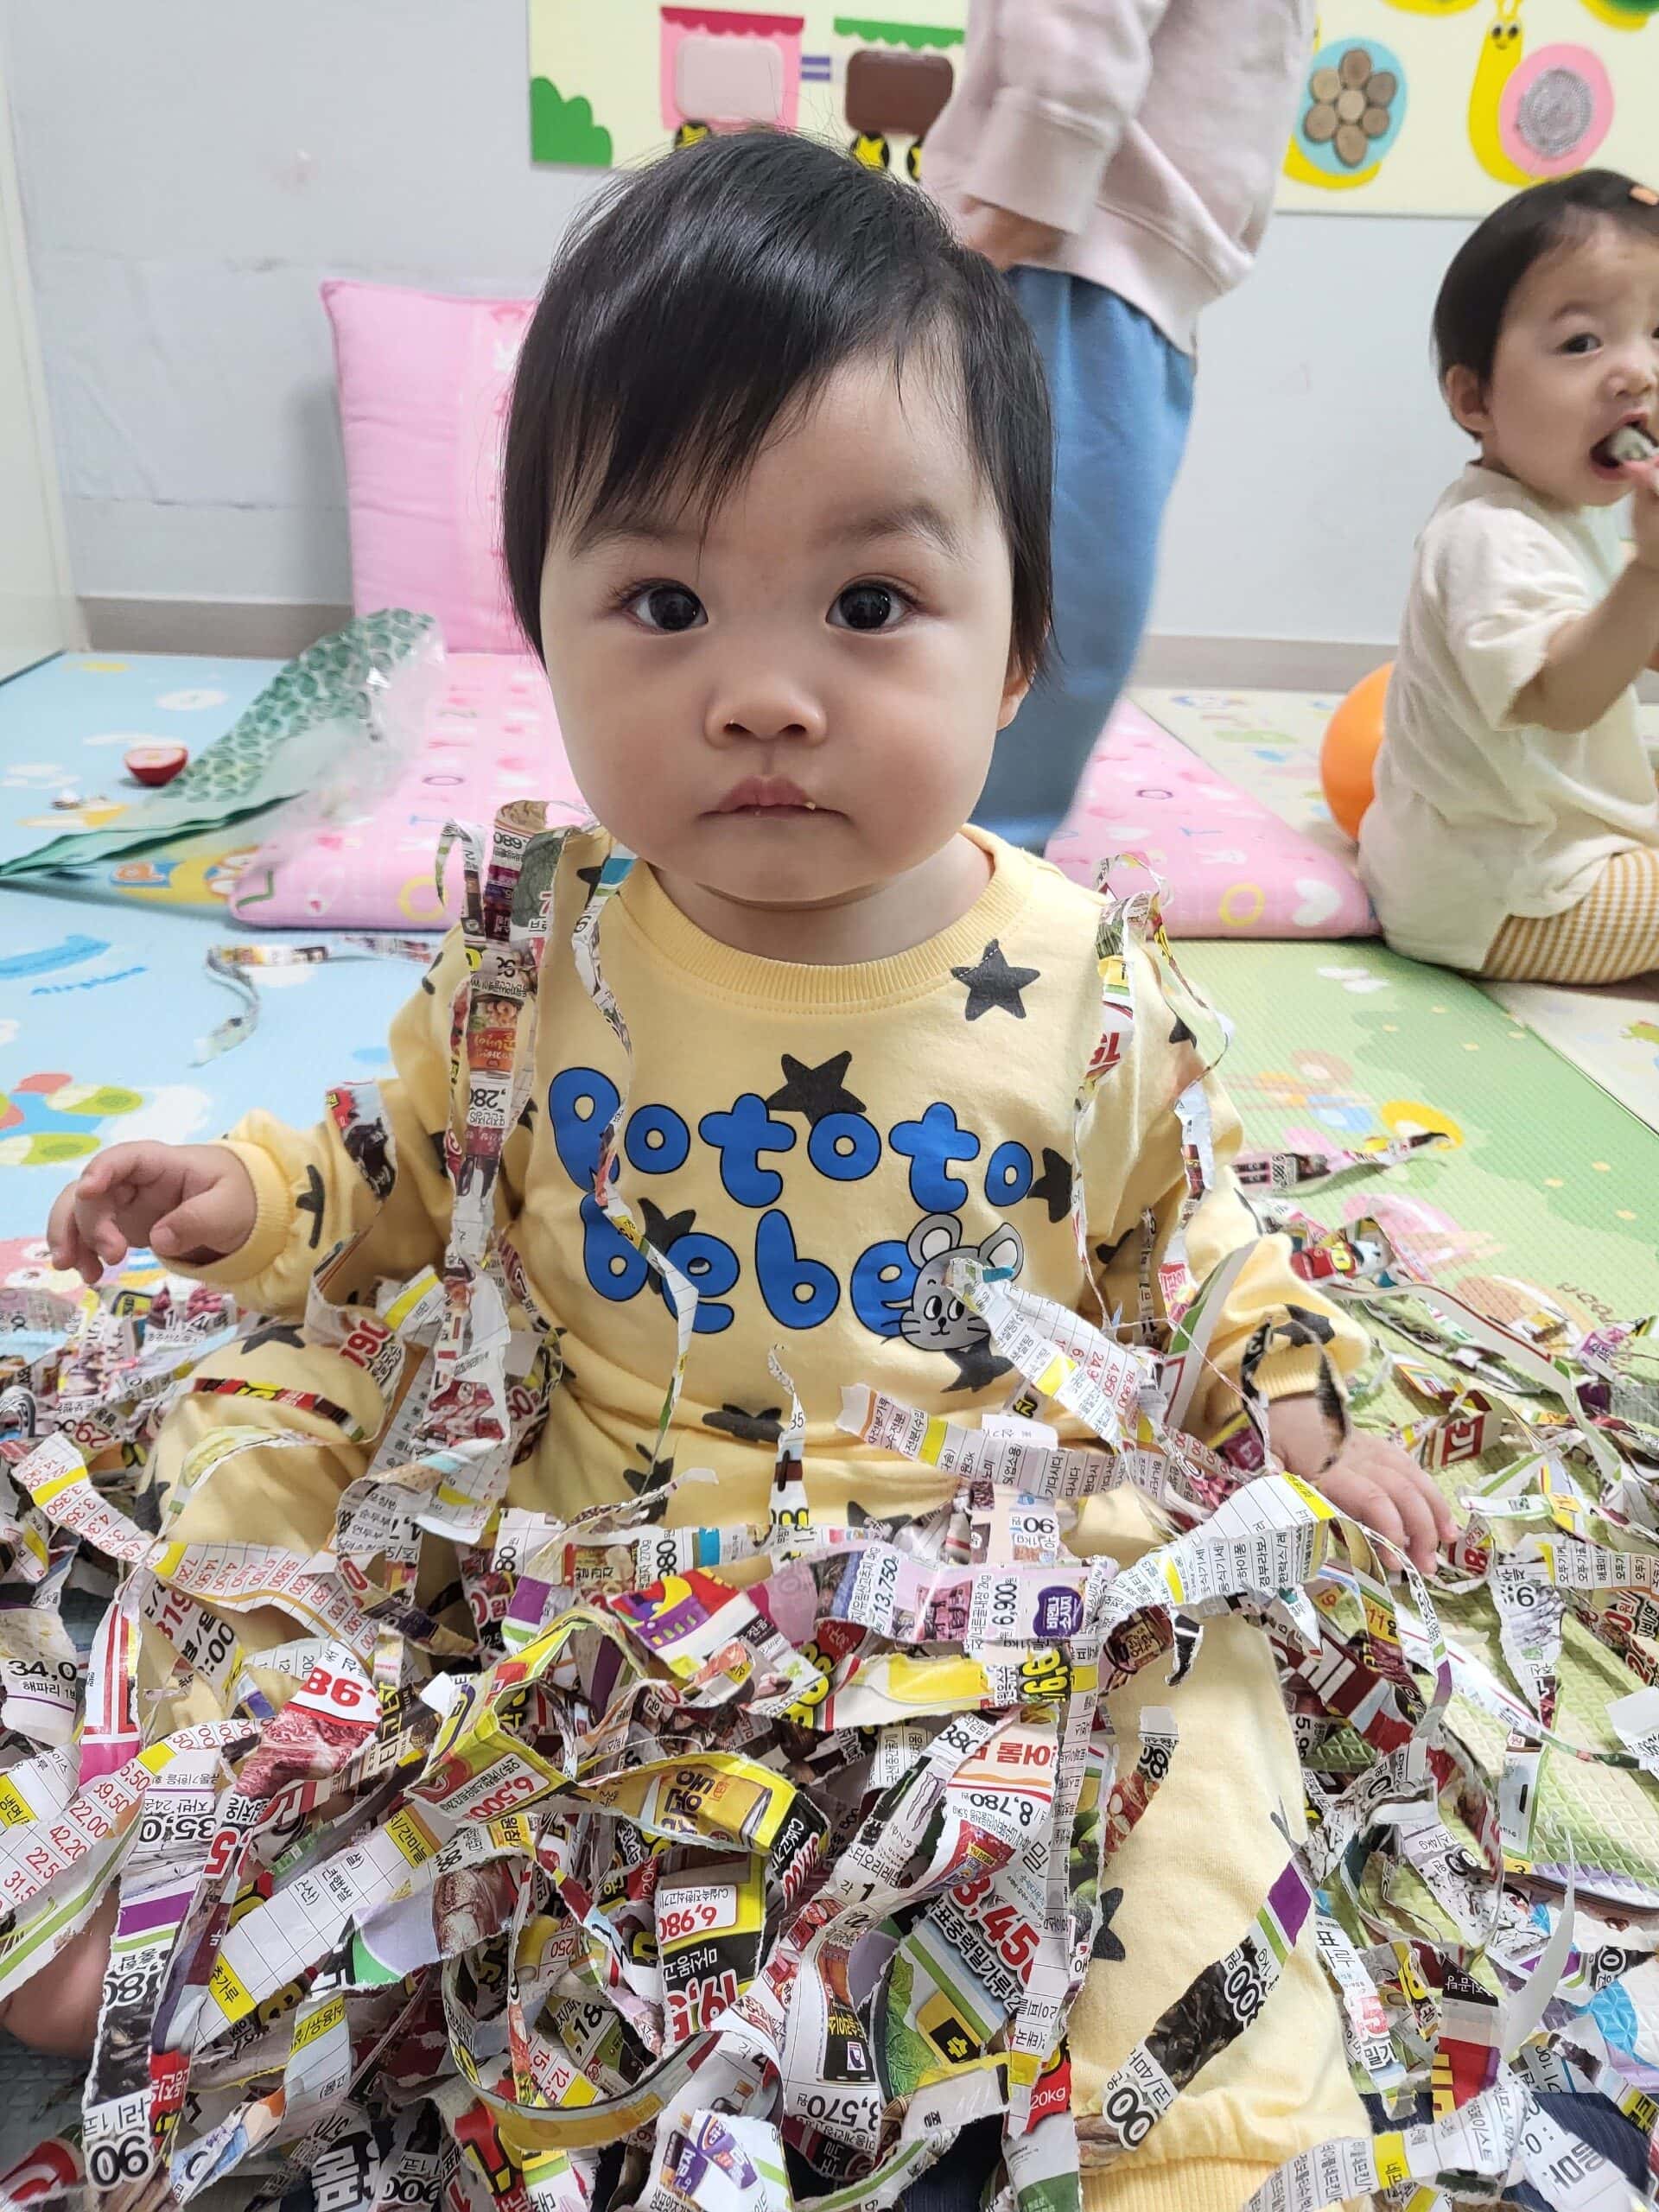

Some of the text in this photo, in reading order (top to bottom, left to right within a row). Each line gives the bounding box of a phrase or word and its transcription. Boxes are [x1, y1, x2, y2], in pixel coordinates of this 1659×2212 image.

[579, 1192, 922, 1336] bebe
[23, 1681, 60, 1696] 해파리
[176, 1798, 208, 1813] 자반
[120, 1948, 158, 1974] 홍합
